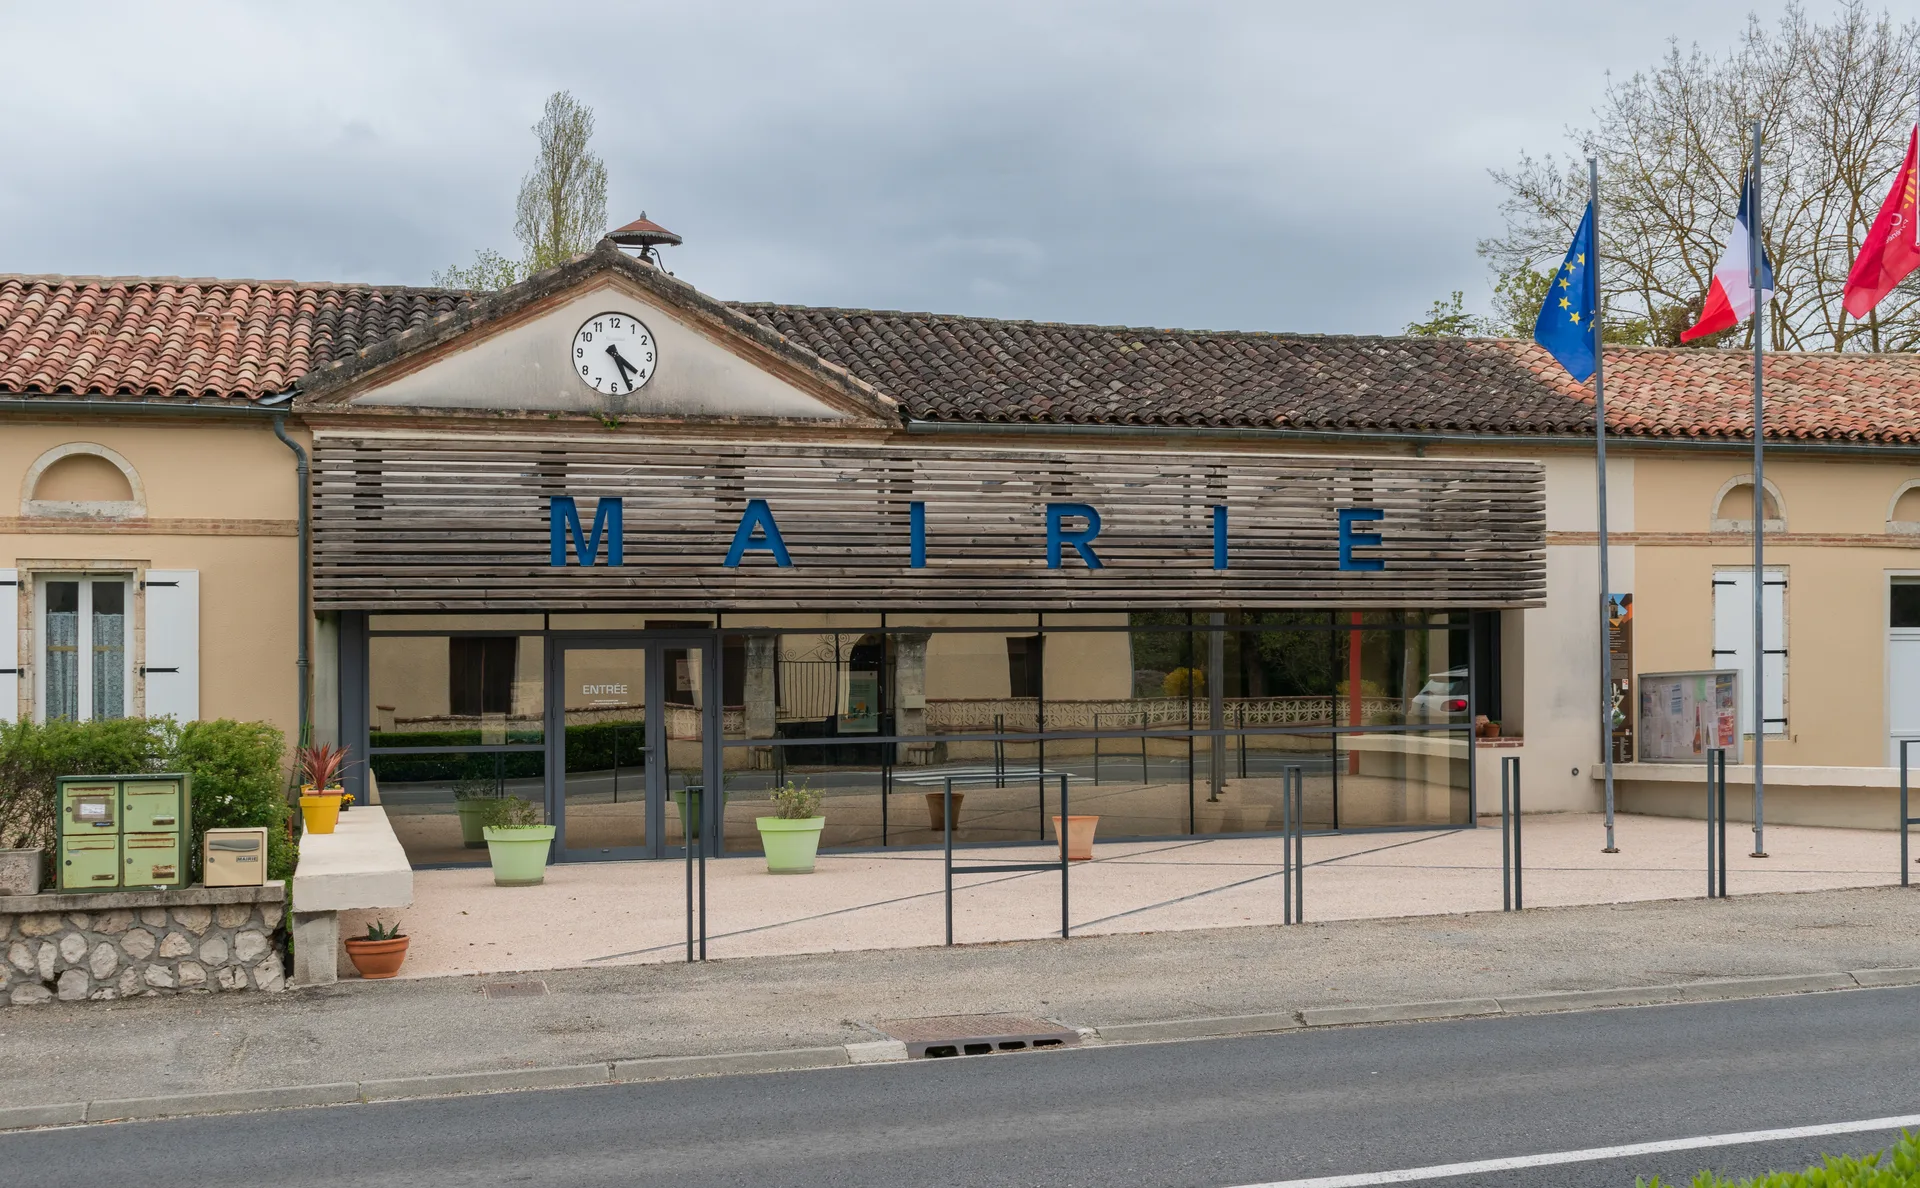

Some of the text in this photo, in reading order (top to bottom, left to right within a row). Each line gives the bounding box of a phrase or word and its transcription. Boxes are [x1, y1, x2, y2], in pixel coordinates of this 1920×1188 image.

[593, 322, 603, 332] 11
[609, 317, 620, 328] 12
[630, 324, 635, 334] 1
[581, 332, 592, 342] 10
[640, 335, 648, 345] 2
[576, 348, 583, 358] 9
[646, 352, 652, 362] 3
[582, 365, 589, 376] 8
[639, 368, 646, 379] 4
[595, 377, 602, 387] 7
[610, 382, 617, 392] 6
[550, 496, 1385, 571] MAIRIE
[582, 683, 628, 695] ENTRÉE
